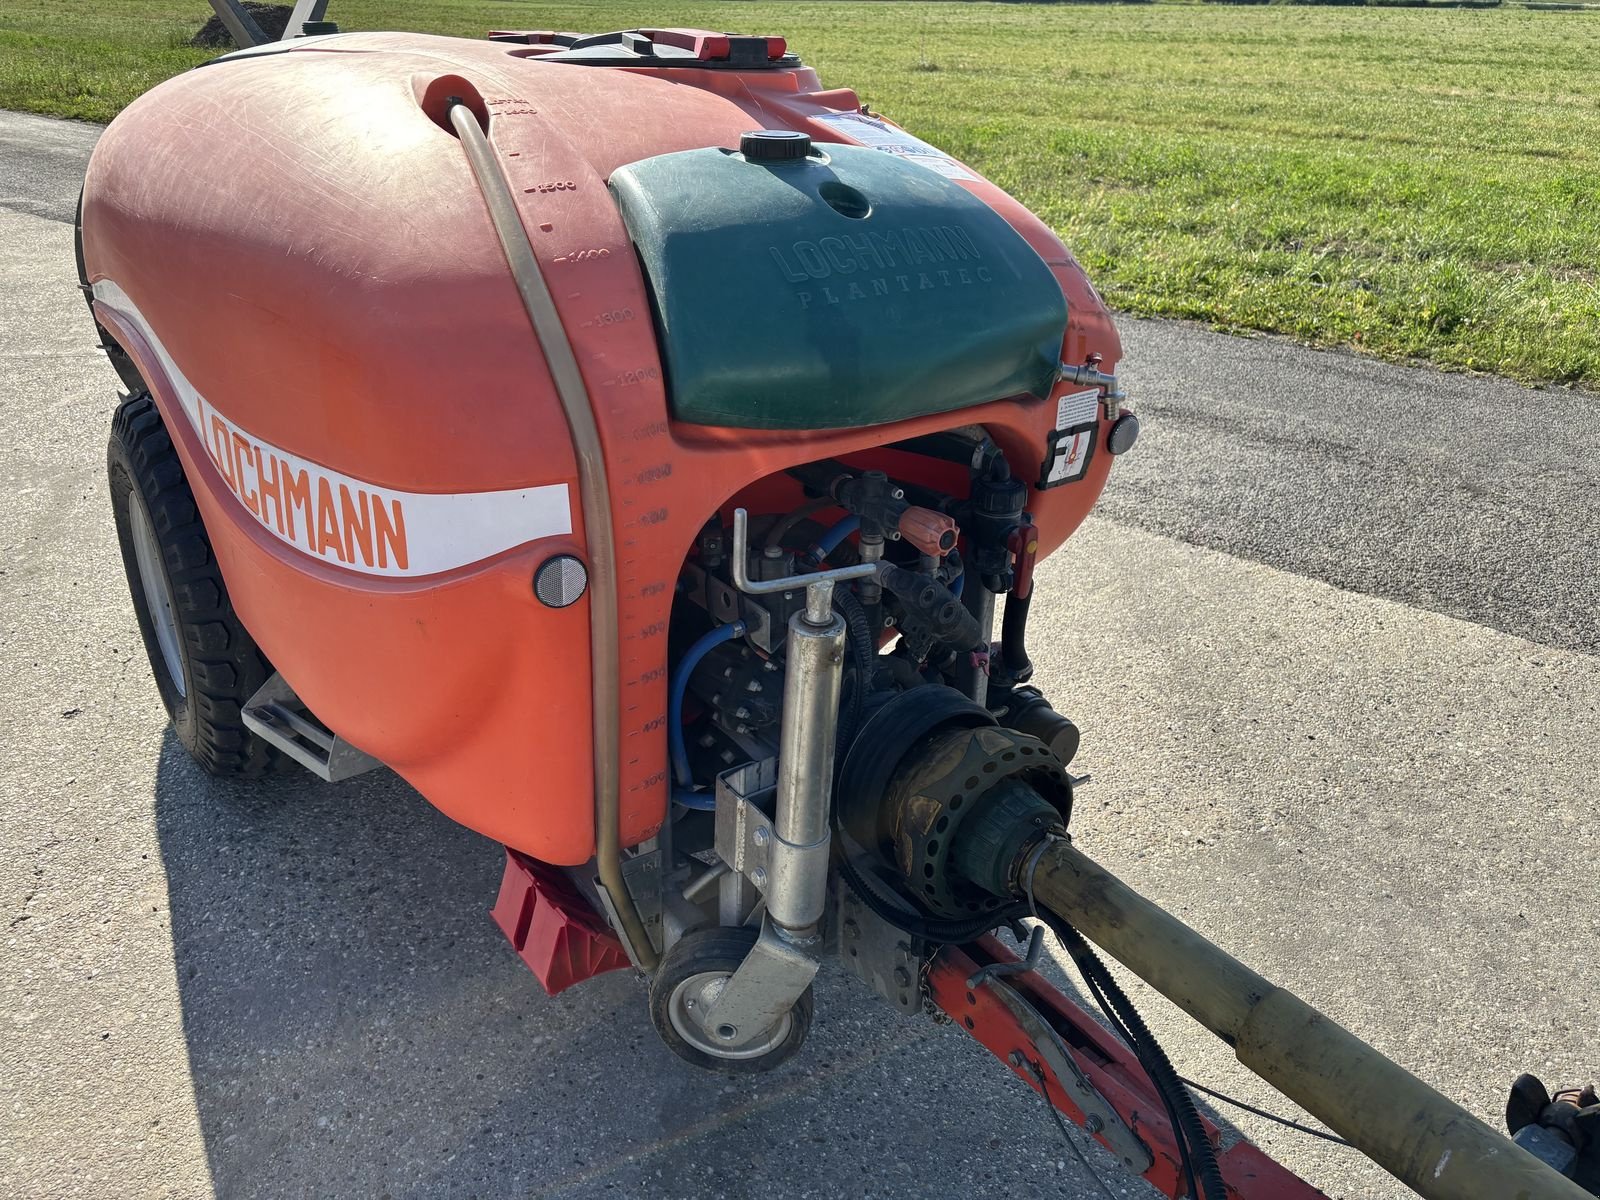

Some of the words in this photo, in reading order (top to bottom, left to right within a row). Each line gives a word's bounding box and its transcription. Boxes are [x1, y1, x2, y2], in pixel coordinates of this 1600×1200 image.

[538, 181, 577, 194] 1500
[769, 225, 982, 283] LOCHMANN
[797, 266, 993, 310] PLANTATEC
[616, 366, 660, 388] 1200
[196, 395, 409, 570] LOCHMANN
[642, 715, 667, 733] 400
